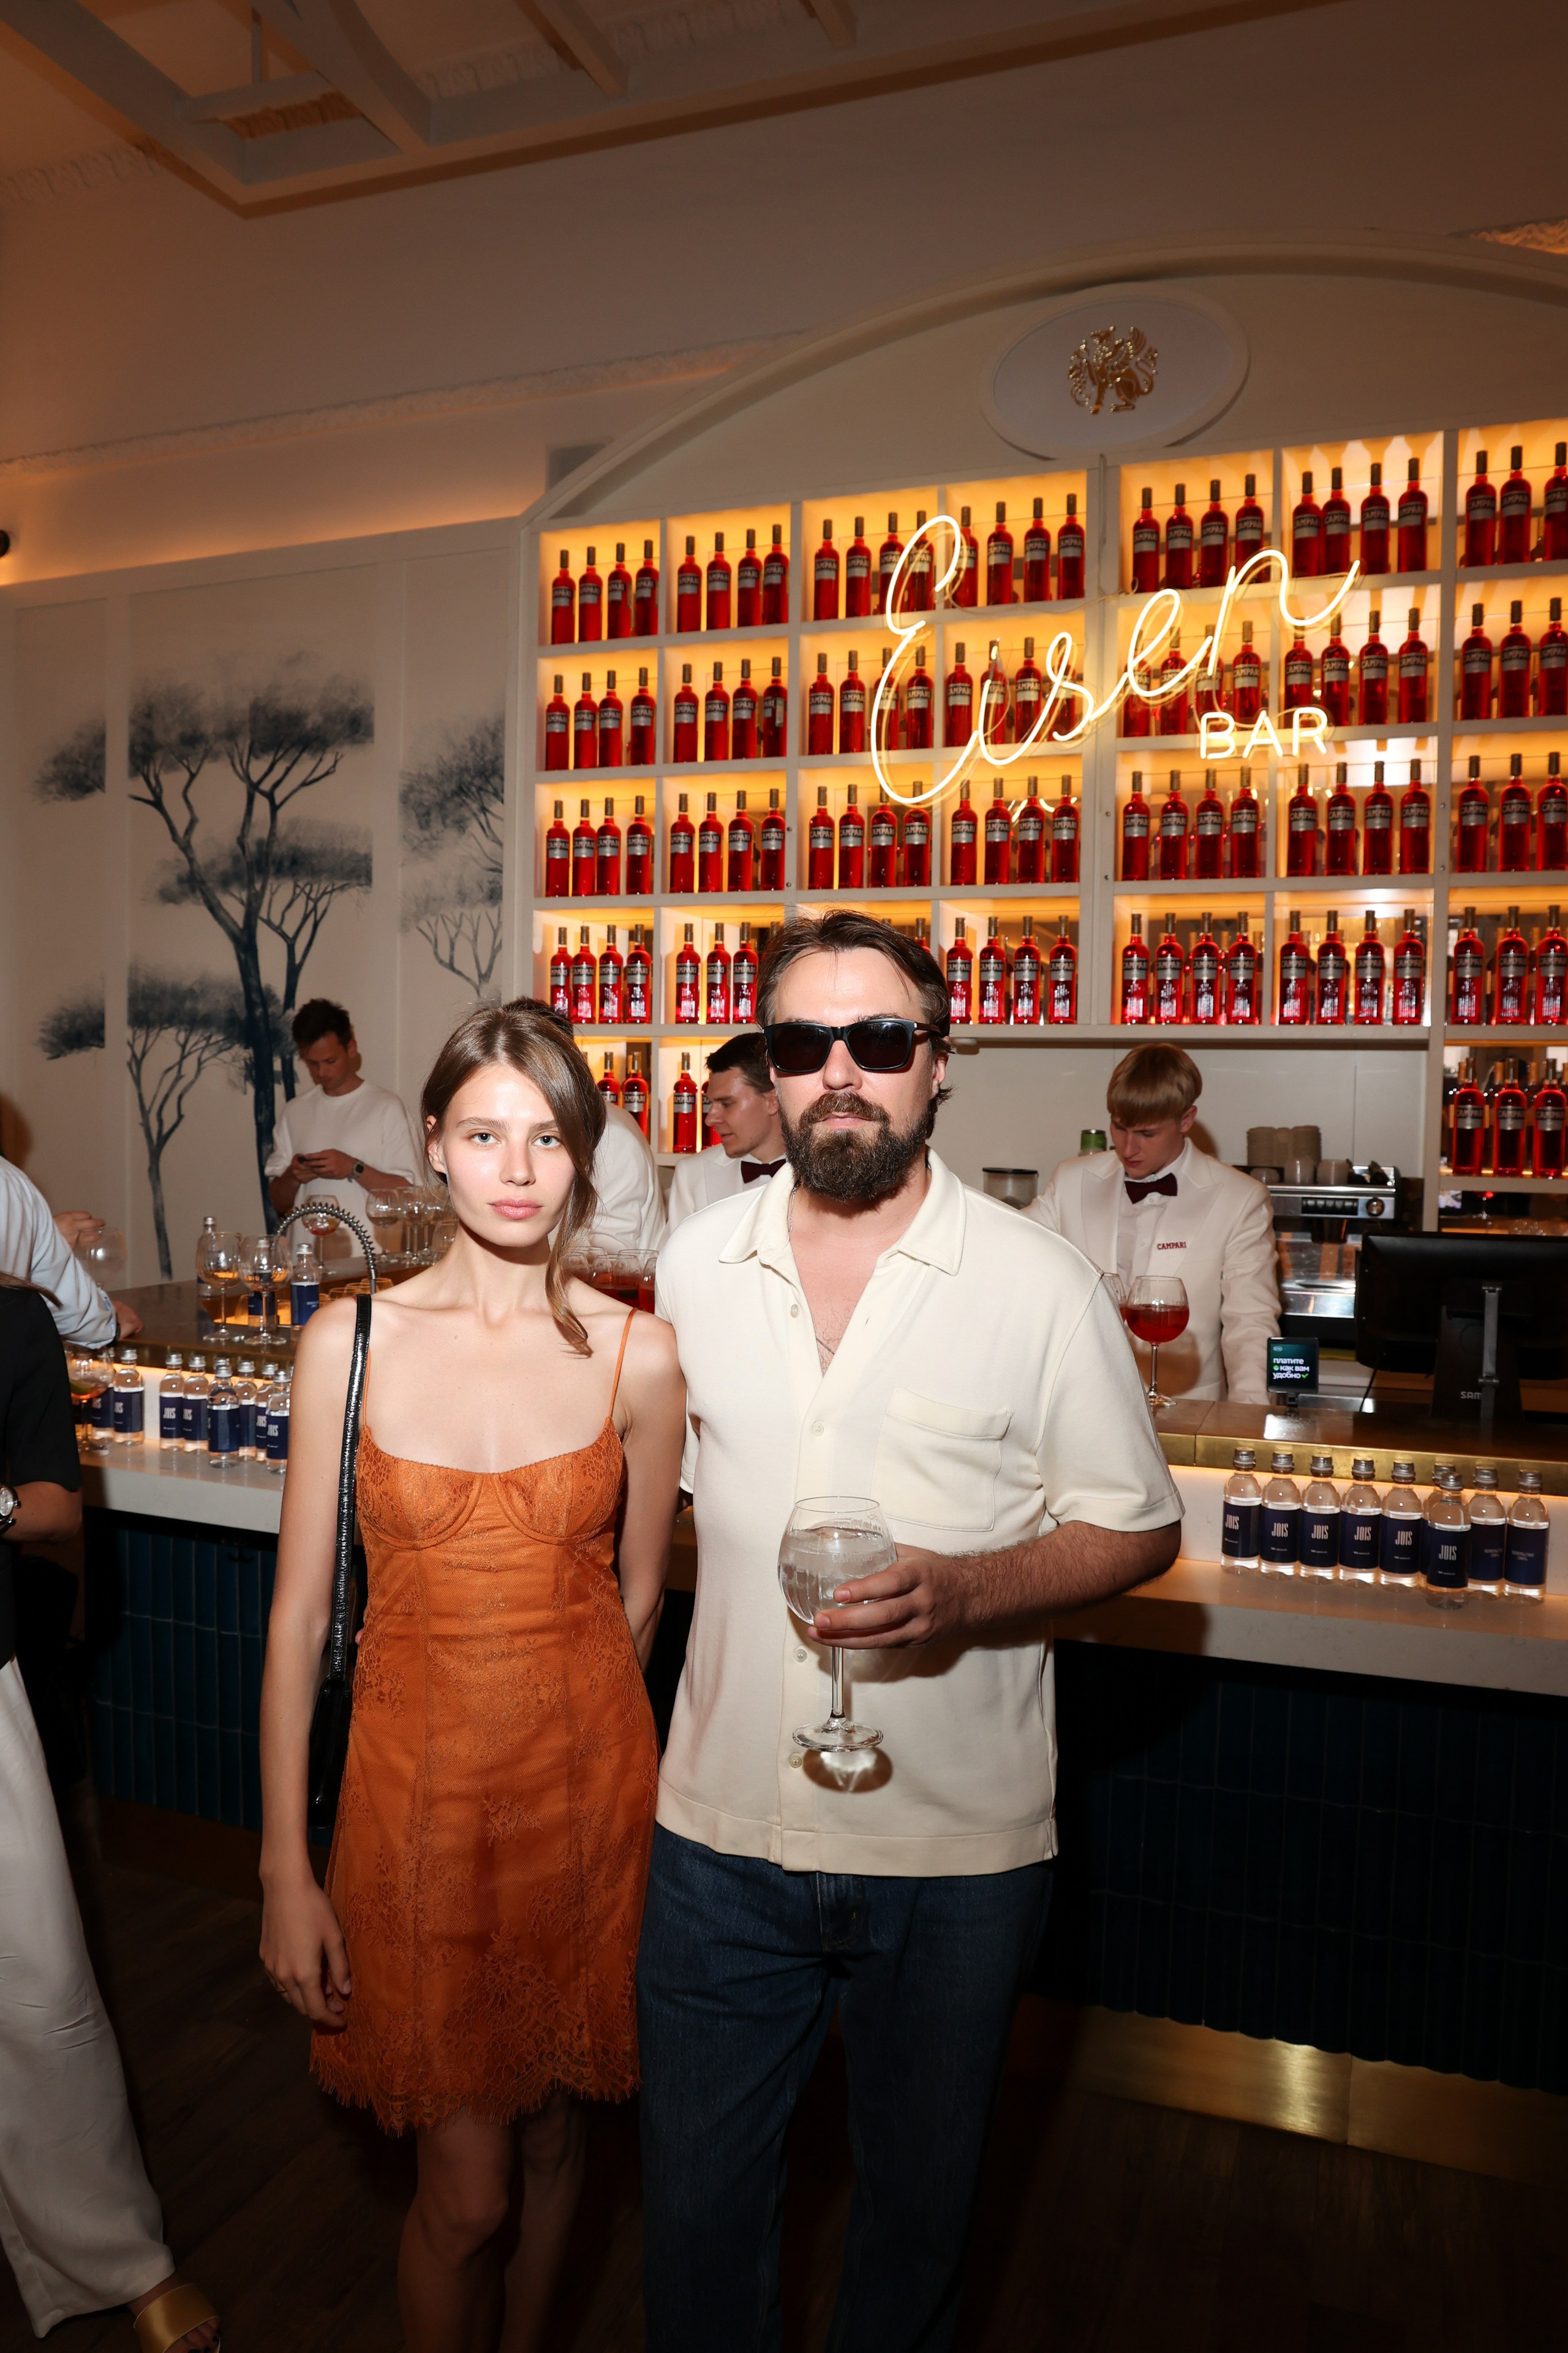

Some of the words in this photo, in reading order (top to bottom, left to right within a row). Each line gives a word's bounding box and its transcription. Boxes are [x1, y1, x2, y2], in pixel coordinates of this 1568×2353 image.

[872, 515, 1361, 804] Eisen
[1199, 706, 1328, 760] BAR
[1460, 1391, 1482, 1400] SAM
[163, 1408, 176, 1419] JOIS
[1226, 1514, 1240, 1530] JOIS
[1272, 1522, 1289, 1537] JOIS
[1311, 1525, 1329, 1539] JOIS
[1354, 1526, 1371, 1541] JOIS
[1395, 1531, 1412, 1546] JOIS
[1439, 1544, 1457, 1561] JOIS
